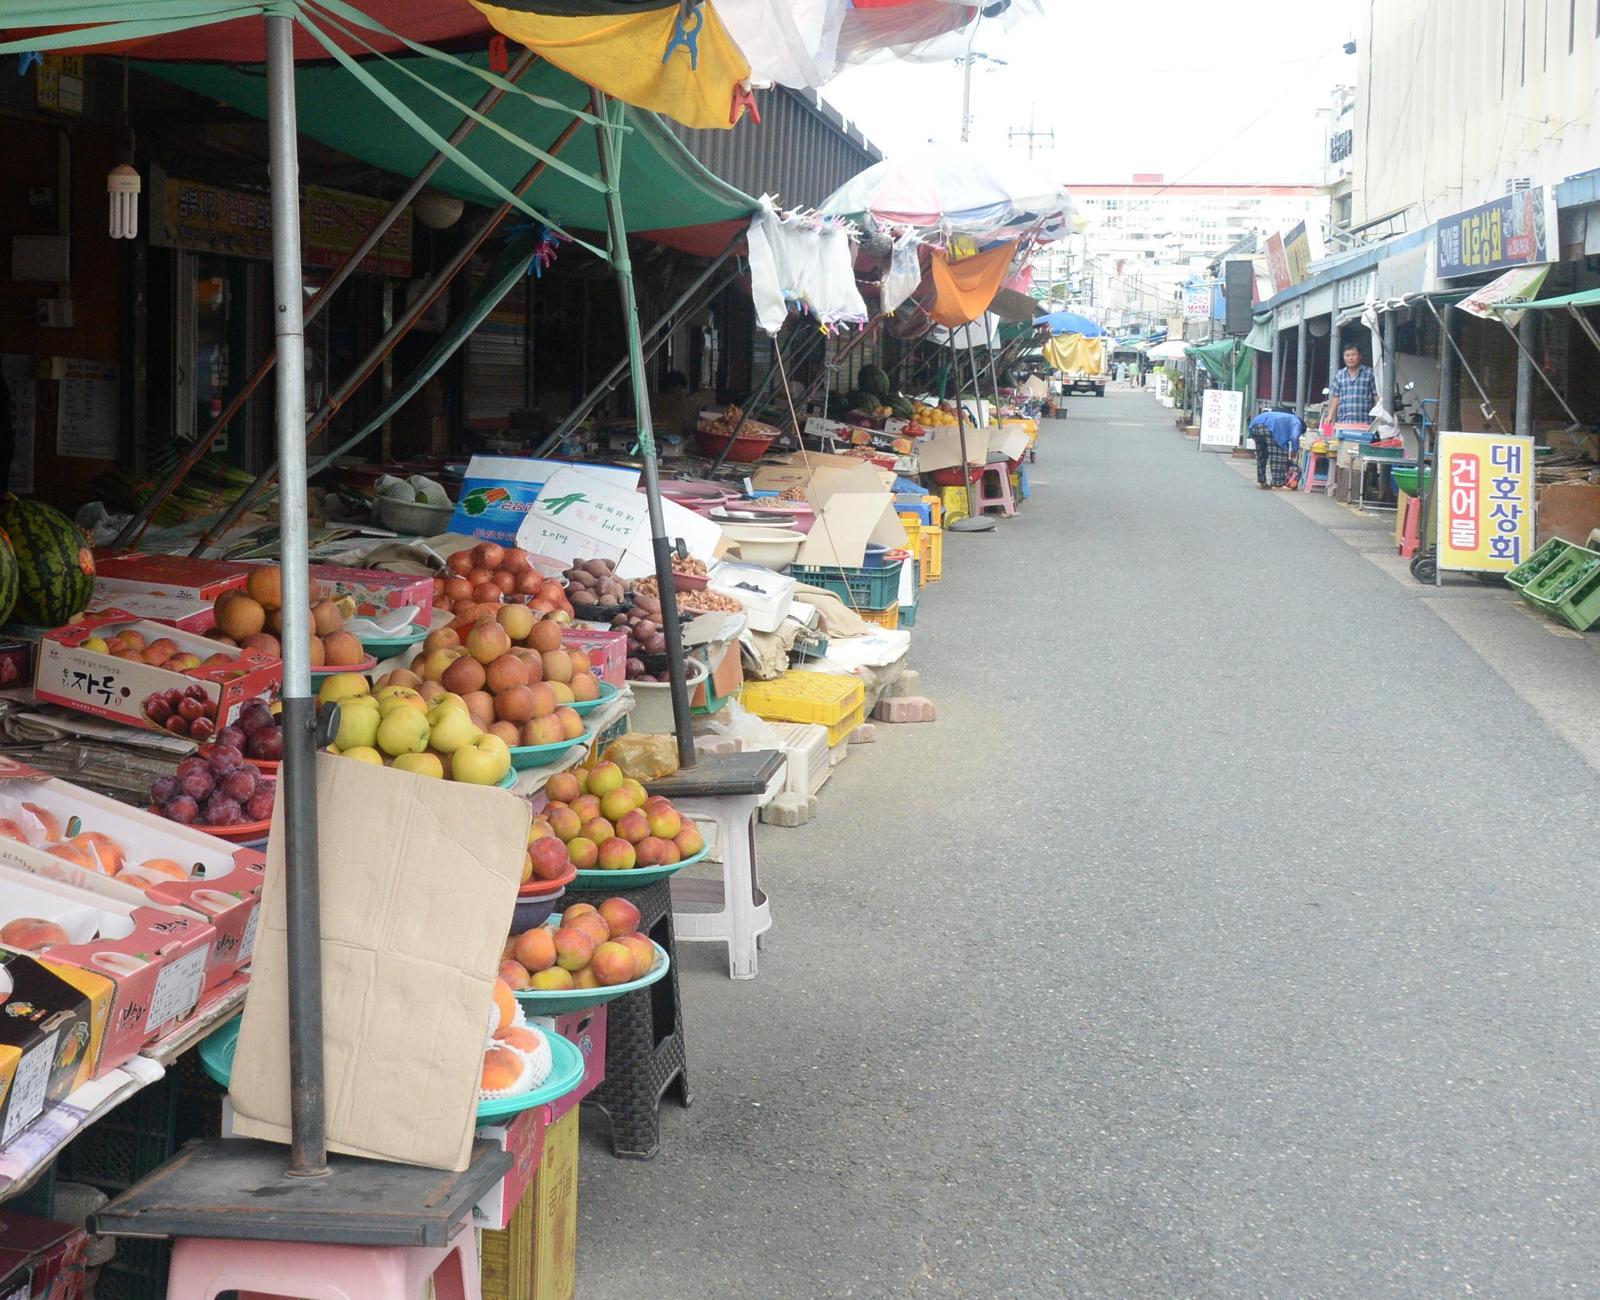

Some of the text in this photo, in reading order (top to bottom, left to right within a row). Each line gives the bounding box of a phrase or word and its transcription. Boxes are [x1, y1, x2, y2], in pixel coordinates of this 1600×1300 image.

[1440, 224, 1459, 268] 건어물
[1462, 208, 1502, 267] 대호상회
[1451, 458, 1476, 548] 건어물
[1489, 445, 1523, 565] 대호상회
[71, 672, 115, 705] 자두
